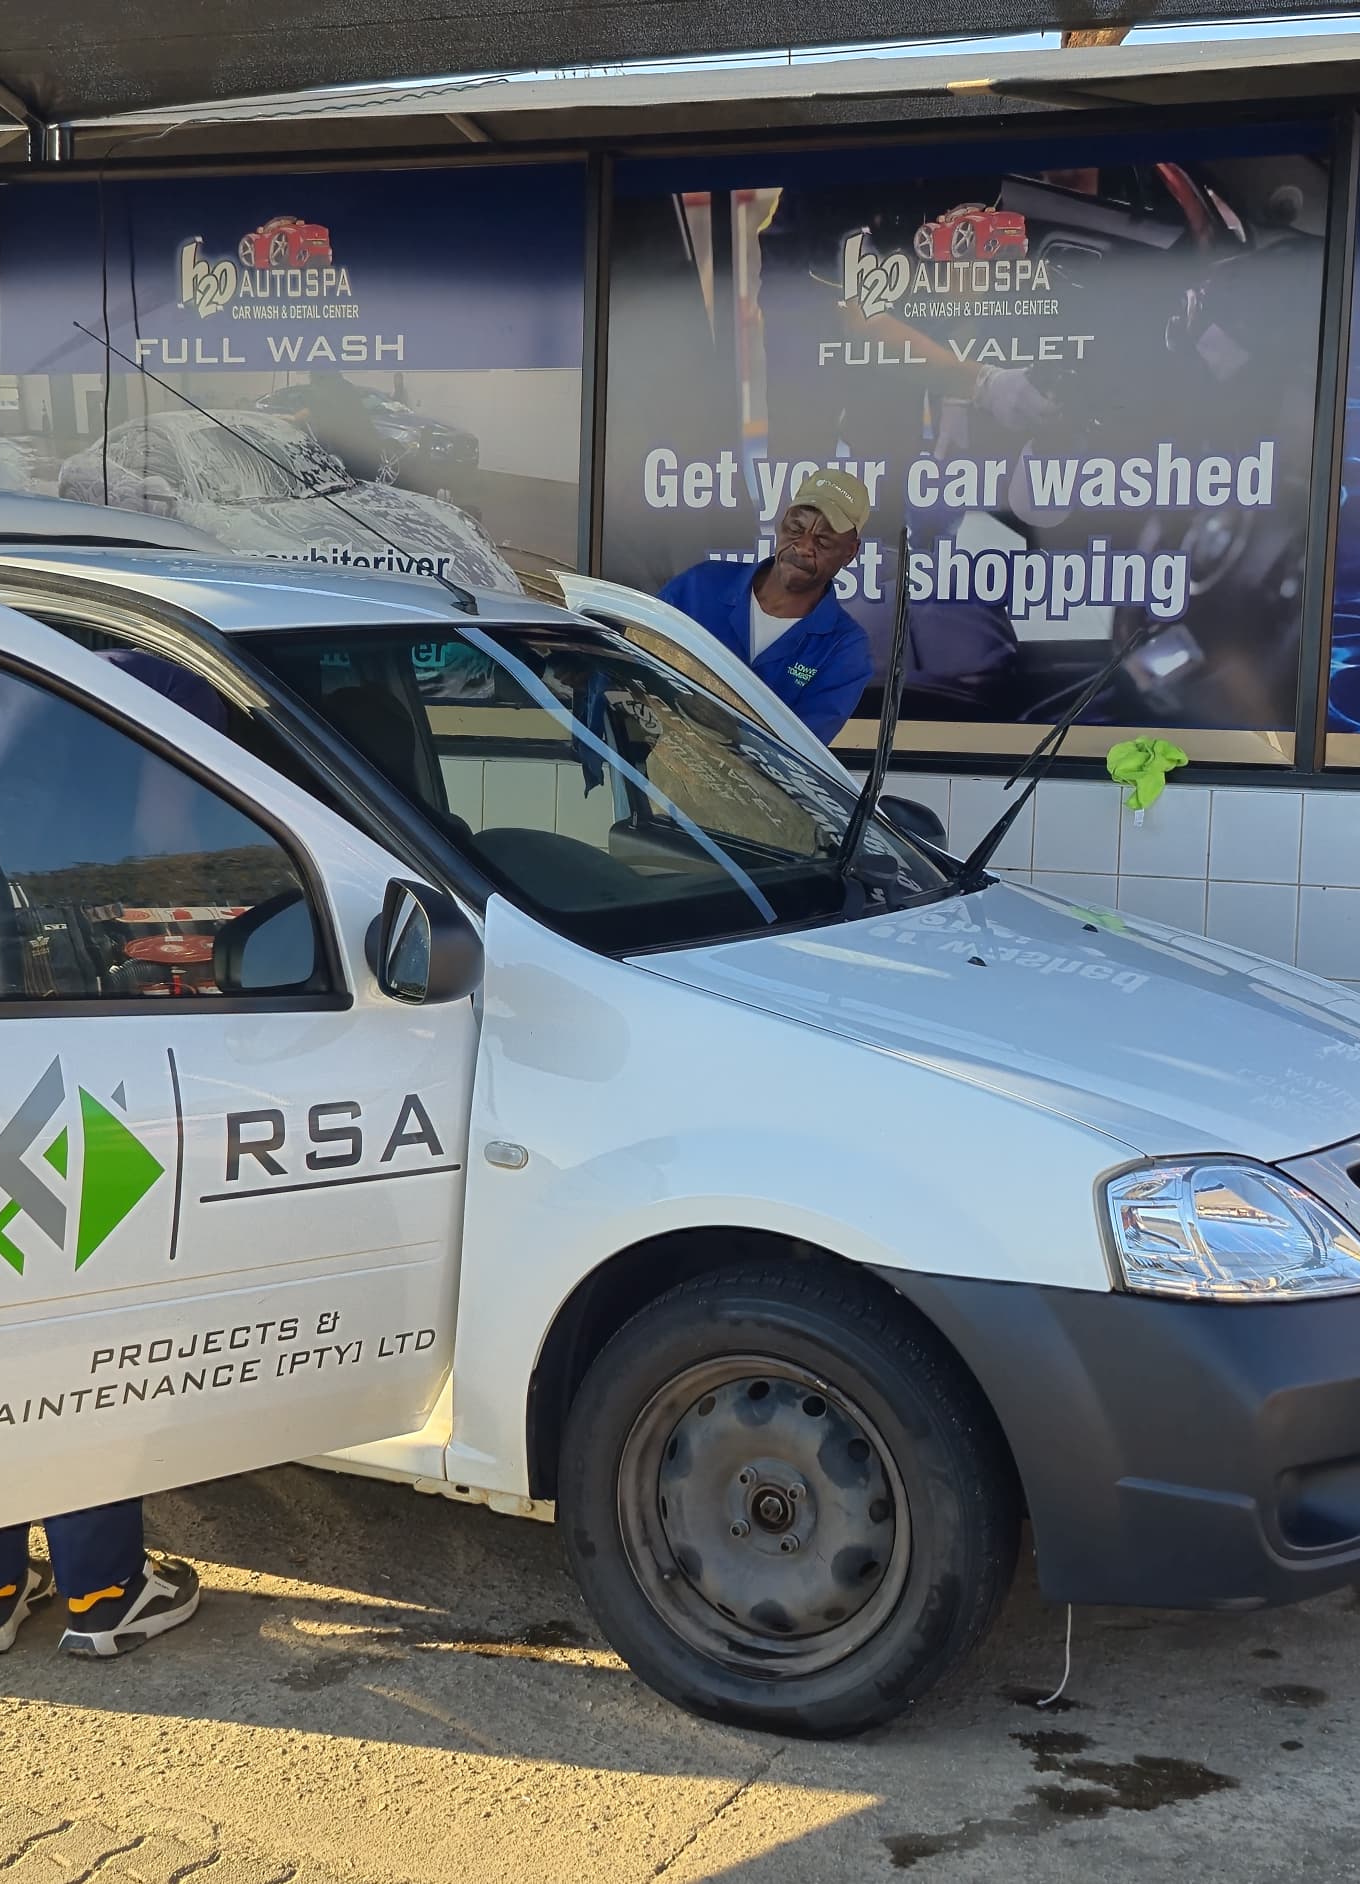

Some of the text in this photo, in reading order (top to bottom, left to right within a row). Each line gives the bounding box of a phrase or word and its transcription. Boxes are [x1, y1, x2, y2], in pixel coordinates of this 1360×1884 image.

[240, 268, 352, 297] AUTOSPA
[913, 259, 1051, 294] AUTOSPA
[232, 304, 359, 320] CAR WASH & DETAIL CENTER
[904, 300, 1058, 318] CAR WASH & DETAIL CENTER
[136, 334, 404, 364] FULL WASH
[818, 335, 1094, 366] FULL VALET
[644, 441, 1274, 522] Get yor car washed
[908, 539, 1188, 618] shopping
[225, 1094, 444, 1181] RSA
[90, 1310, 340, 1373] PROJECTS &
[377, 1328, 436, 1359] LTD
